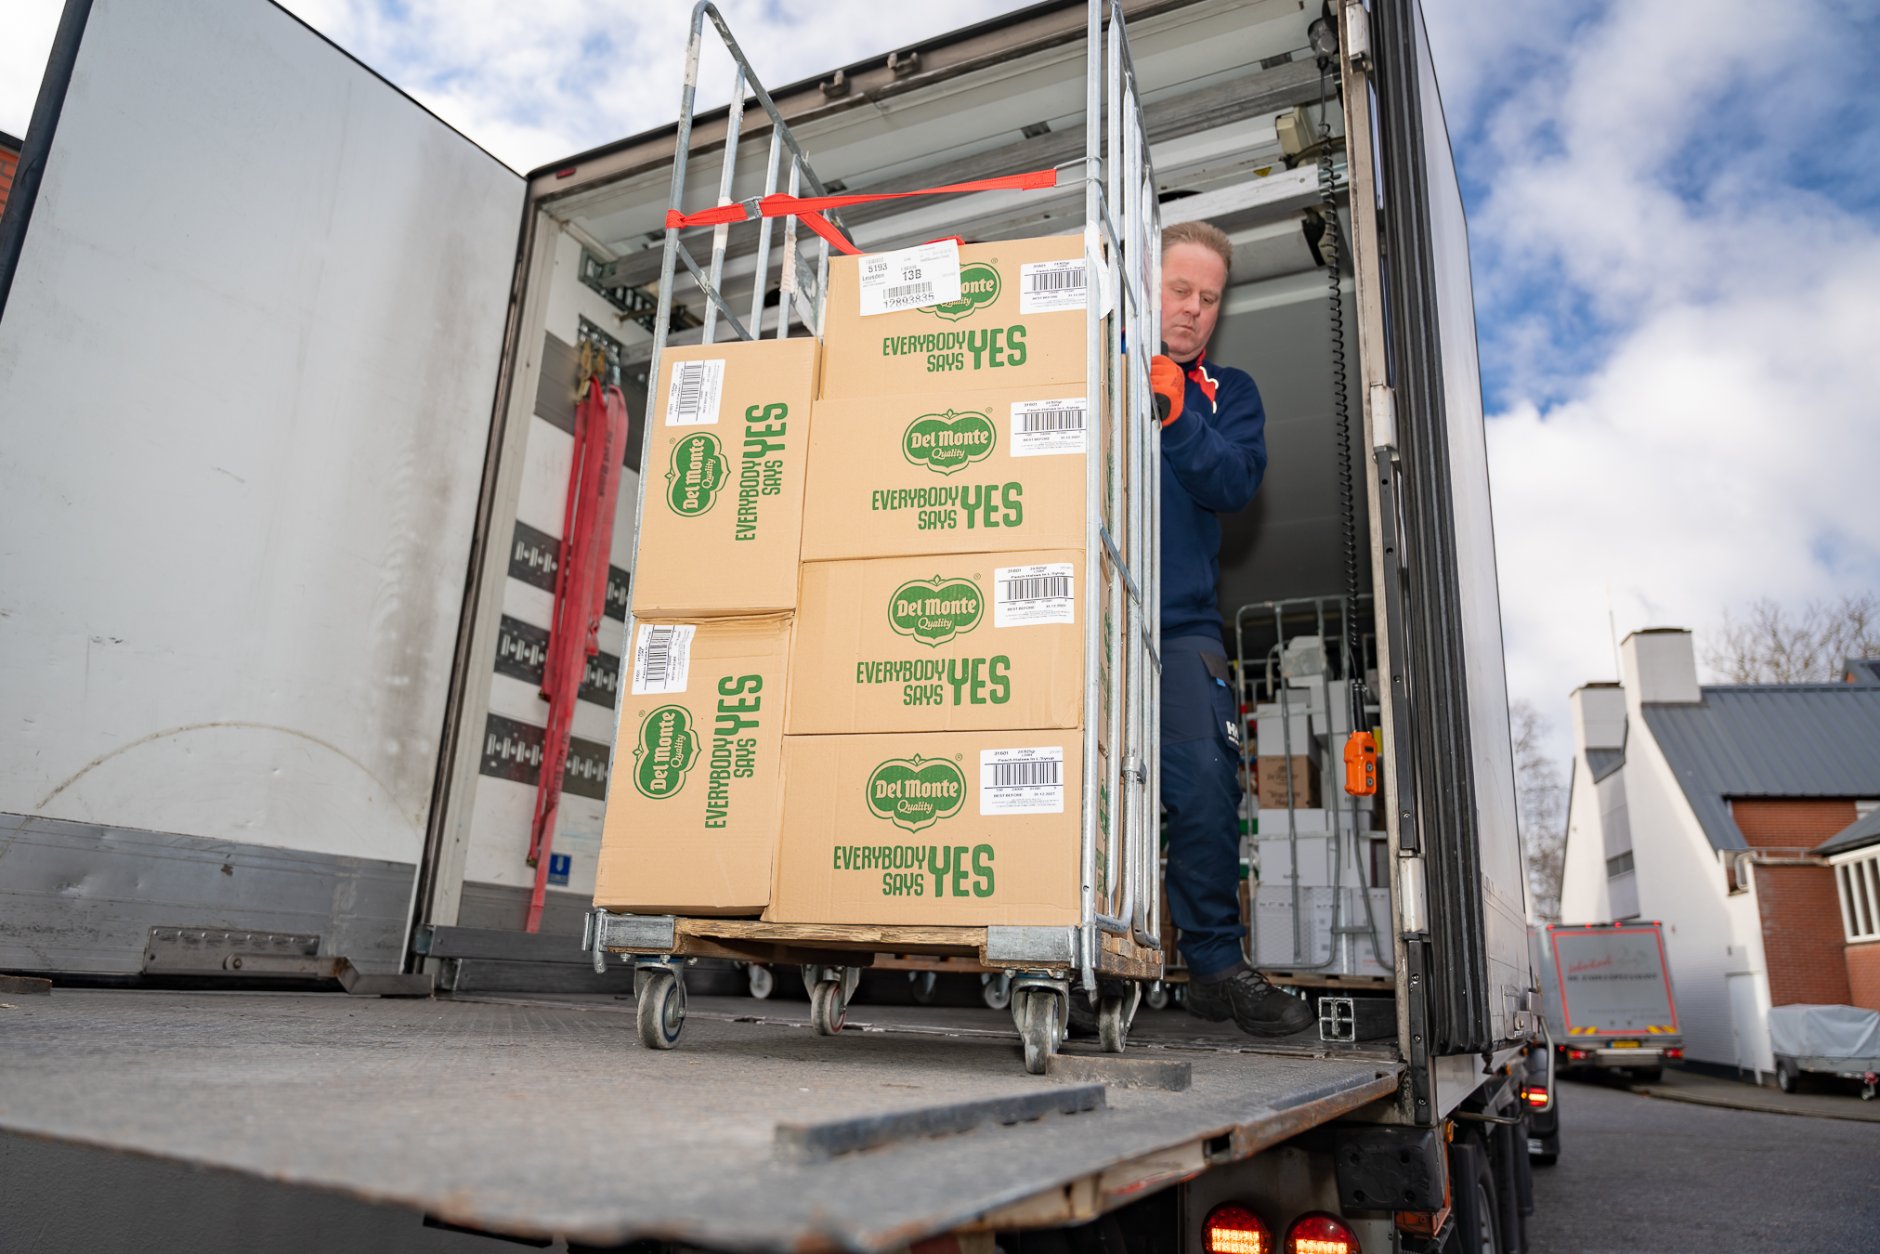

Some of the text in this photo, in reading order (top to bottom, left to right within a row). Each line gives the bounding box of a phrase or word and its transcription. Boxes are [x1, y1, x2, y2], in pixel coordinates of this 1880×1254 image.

[867, 263, 888, 273] 5193
[902, 269, 922, 281] 13B
[961, 279, 995, 294] onte
[883, 330, 966, 356] EVERYBODY
[967, 324, 1027, 370] YES
[927, 353, 964, 373] SAYS
[742, 402, 788, 458] YES
[911, 428, 989, 448] Del Monte
[931, 447, 965, 459] Quality
[682, 438, 705, 510] Del Monte
[701, 458, 716, 489] Quality
[761, 459, 783, 496] SAYS
[735, 460, 762, 541] EVERYBODY
[872, 485, 959, 511] EVERYBODY
[960, 481, 1023, 530] YES
[918, 509, 957, 530] SAYS
[896, 598, 977, 617] Del Monte
[918, 617, 953, 630] Quality
[856, 658, 946, 684] EVERYBODY
[947, 655, 1011, 706] YES
[714, 674, 763, 735] YES
[903, 684, 944, 706] SAYS
[650, 711, 675, 791] Del Monte
[670, 733, 686, 768] Quality
[733, 738, 757, 778] SAYS
[704, 738, 734, 828] EVERYBODY
[875, 778, 959, 799] Del Monte
[897, 799, 933, 813] Quality
[833, 845, 926, 870] EVERYBODY
[927, 843, 995, 898] YES
[882, 872, 924, 896] SAYS
